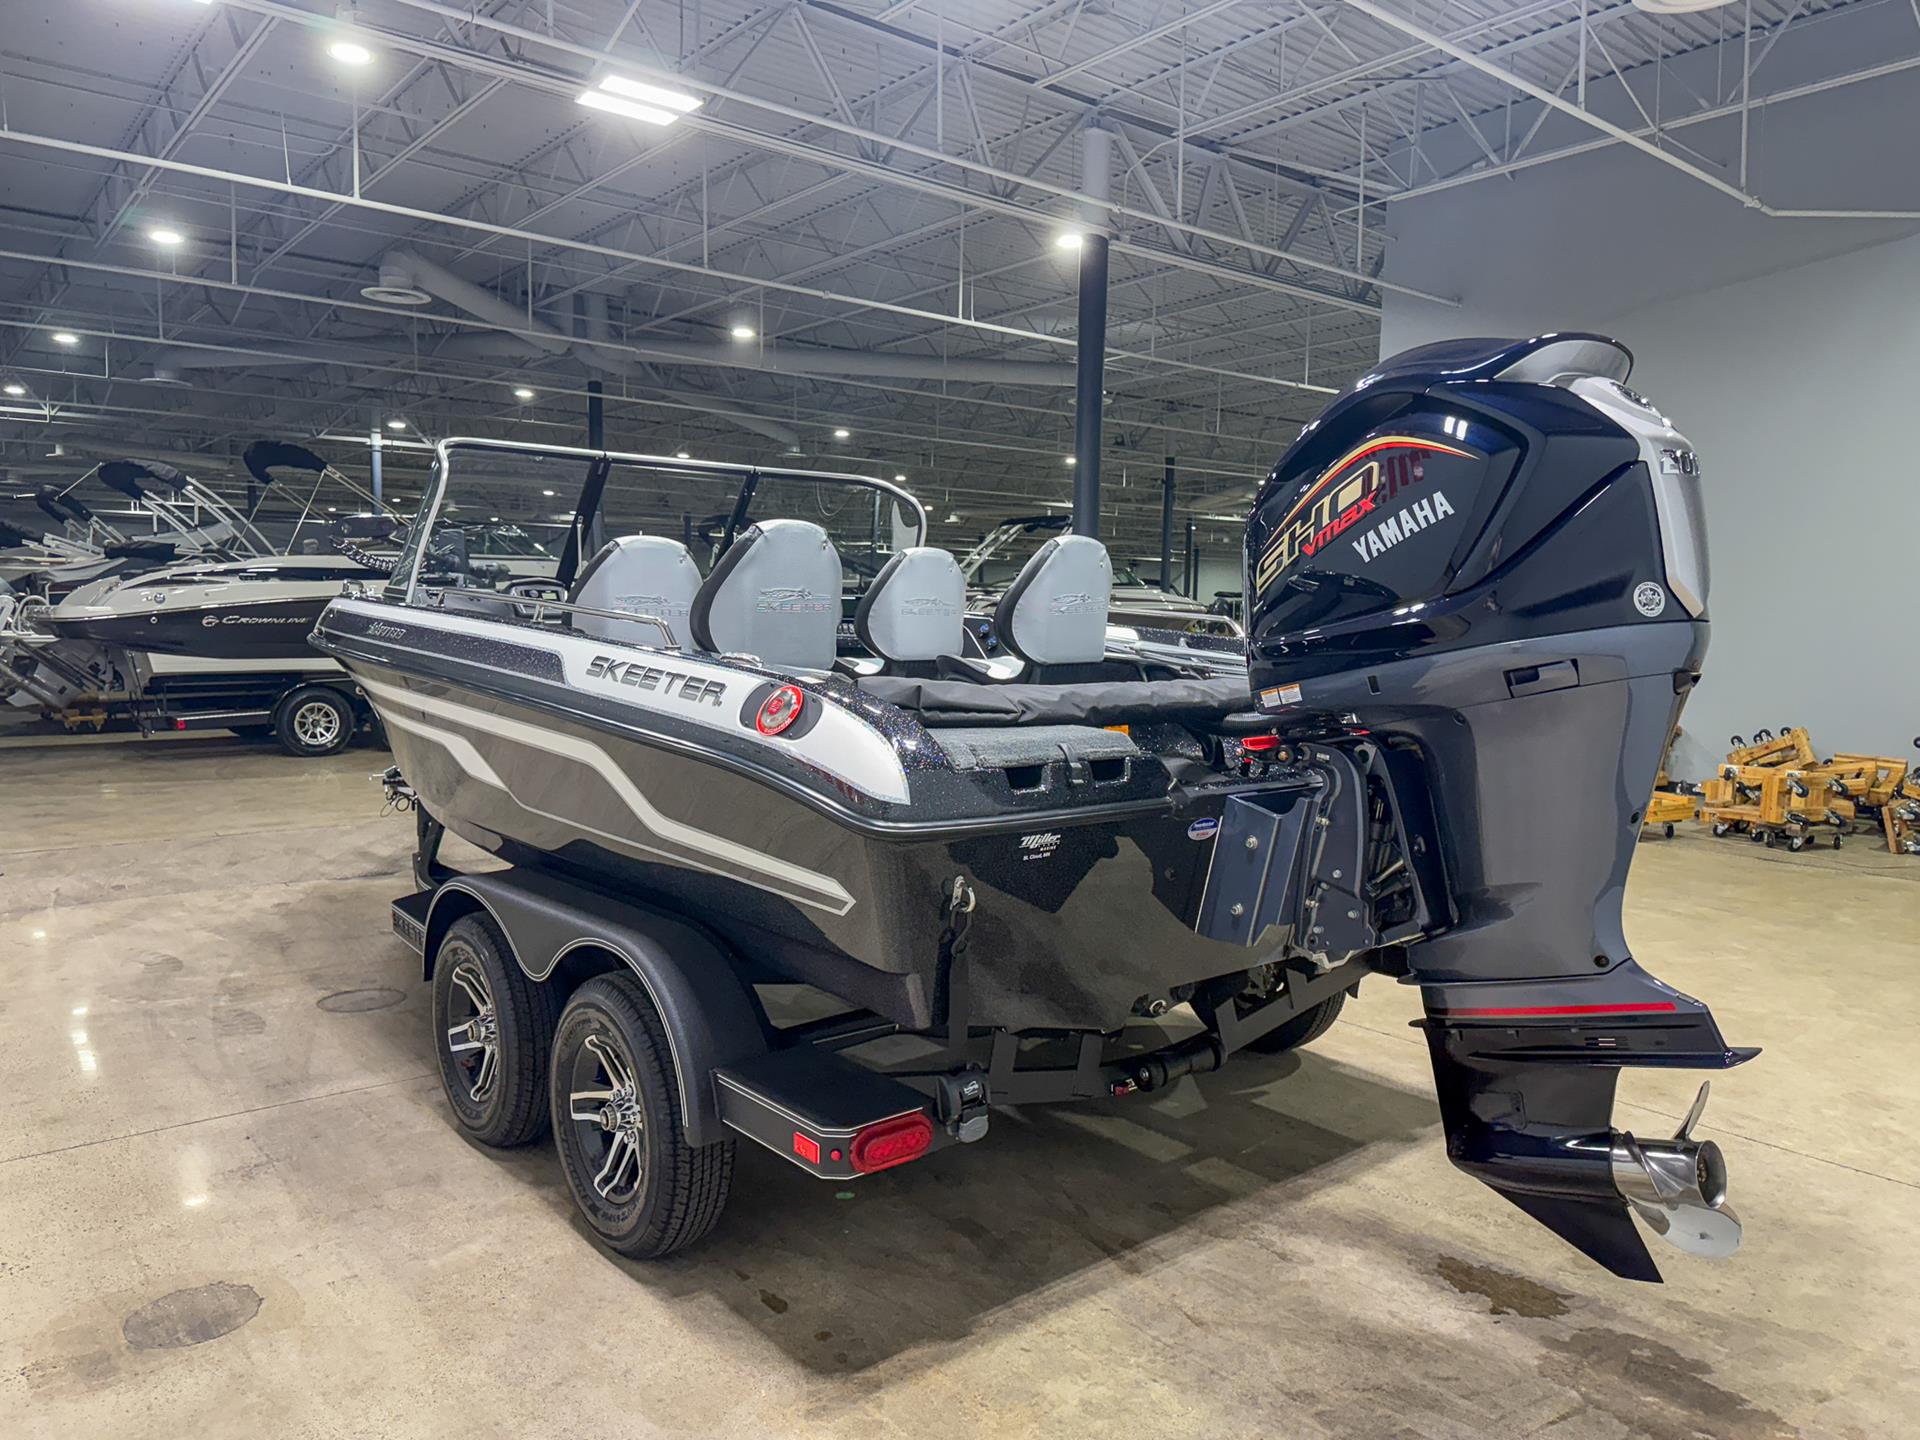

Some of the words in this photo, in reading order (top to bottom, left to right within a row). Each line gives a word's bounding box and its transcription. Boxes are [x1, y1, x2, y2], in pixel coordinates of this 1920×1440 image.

[1352, 490, 1455, 564] YAMAHA
[756, 603, 832, 613] SKEETER
[586, 655, 728, 706] SKEETER
[1018, 833, 1061, 849] Miller
